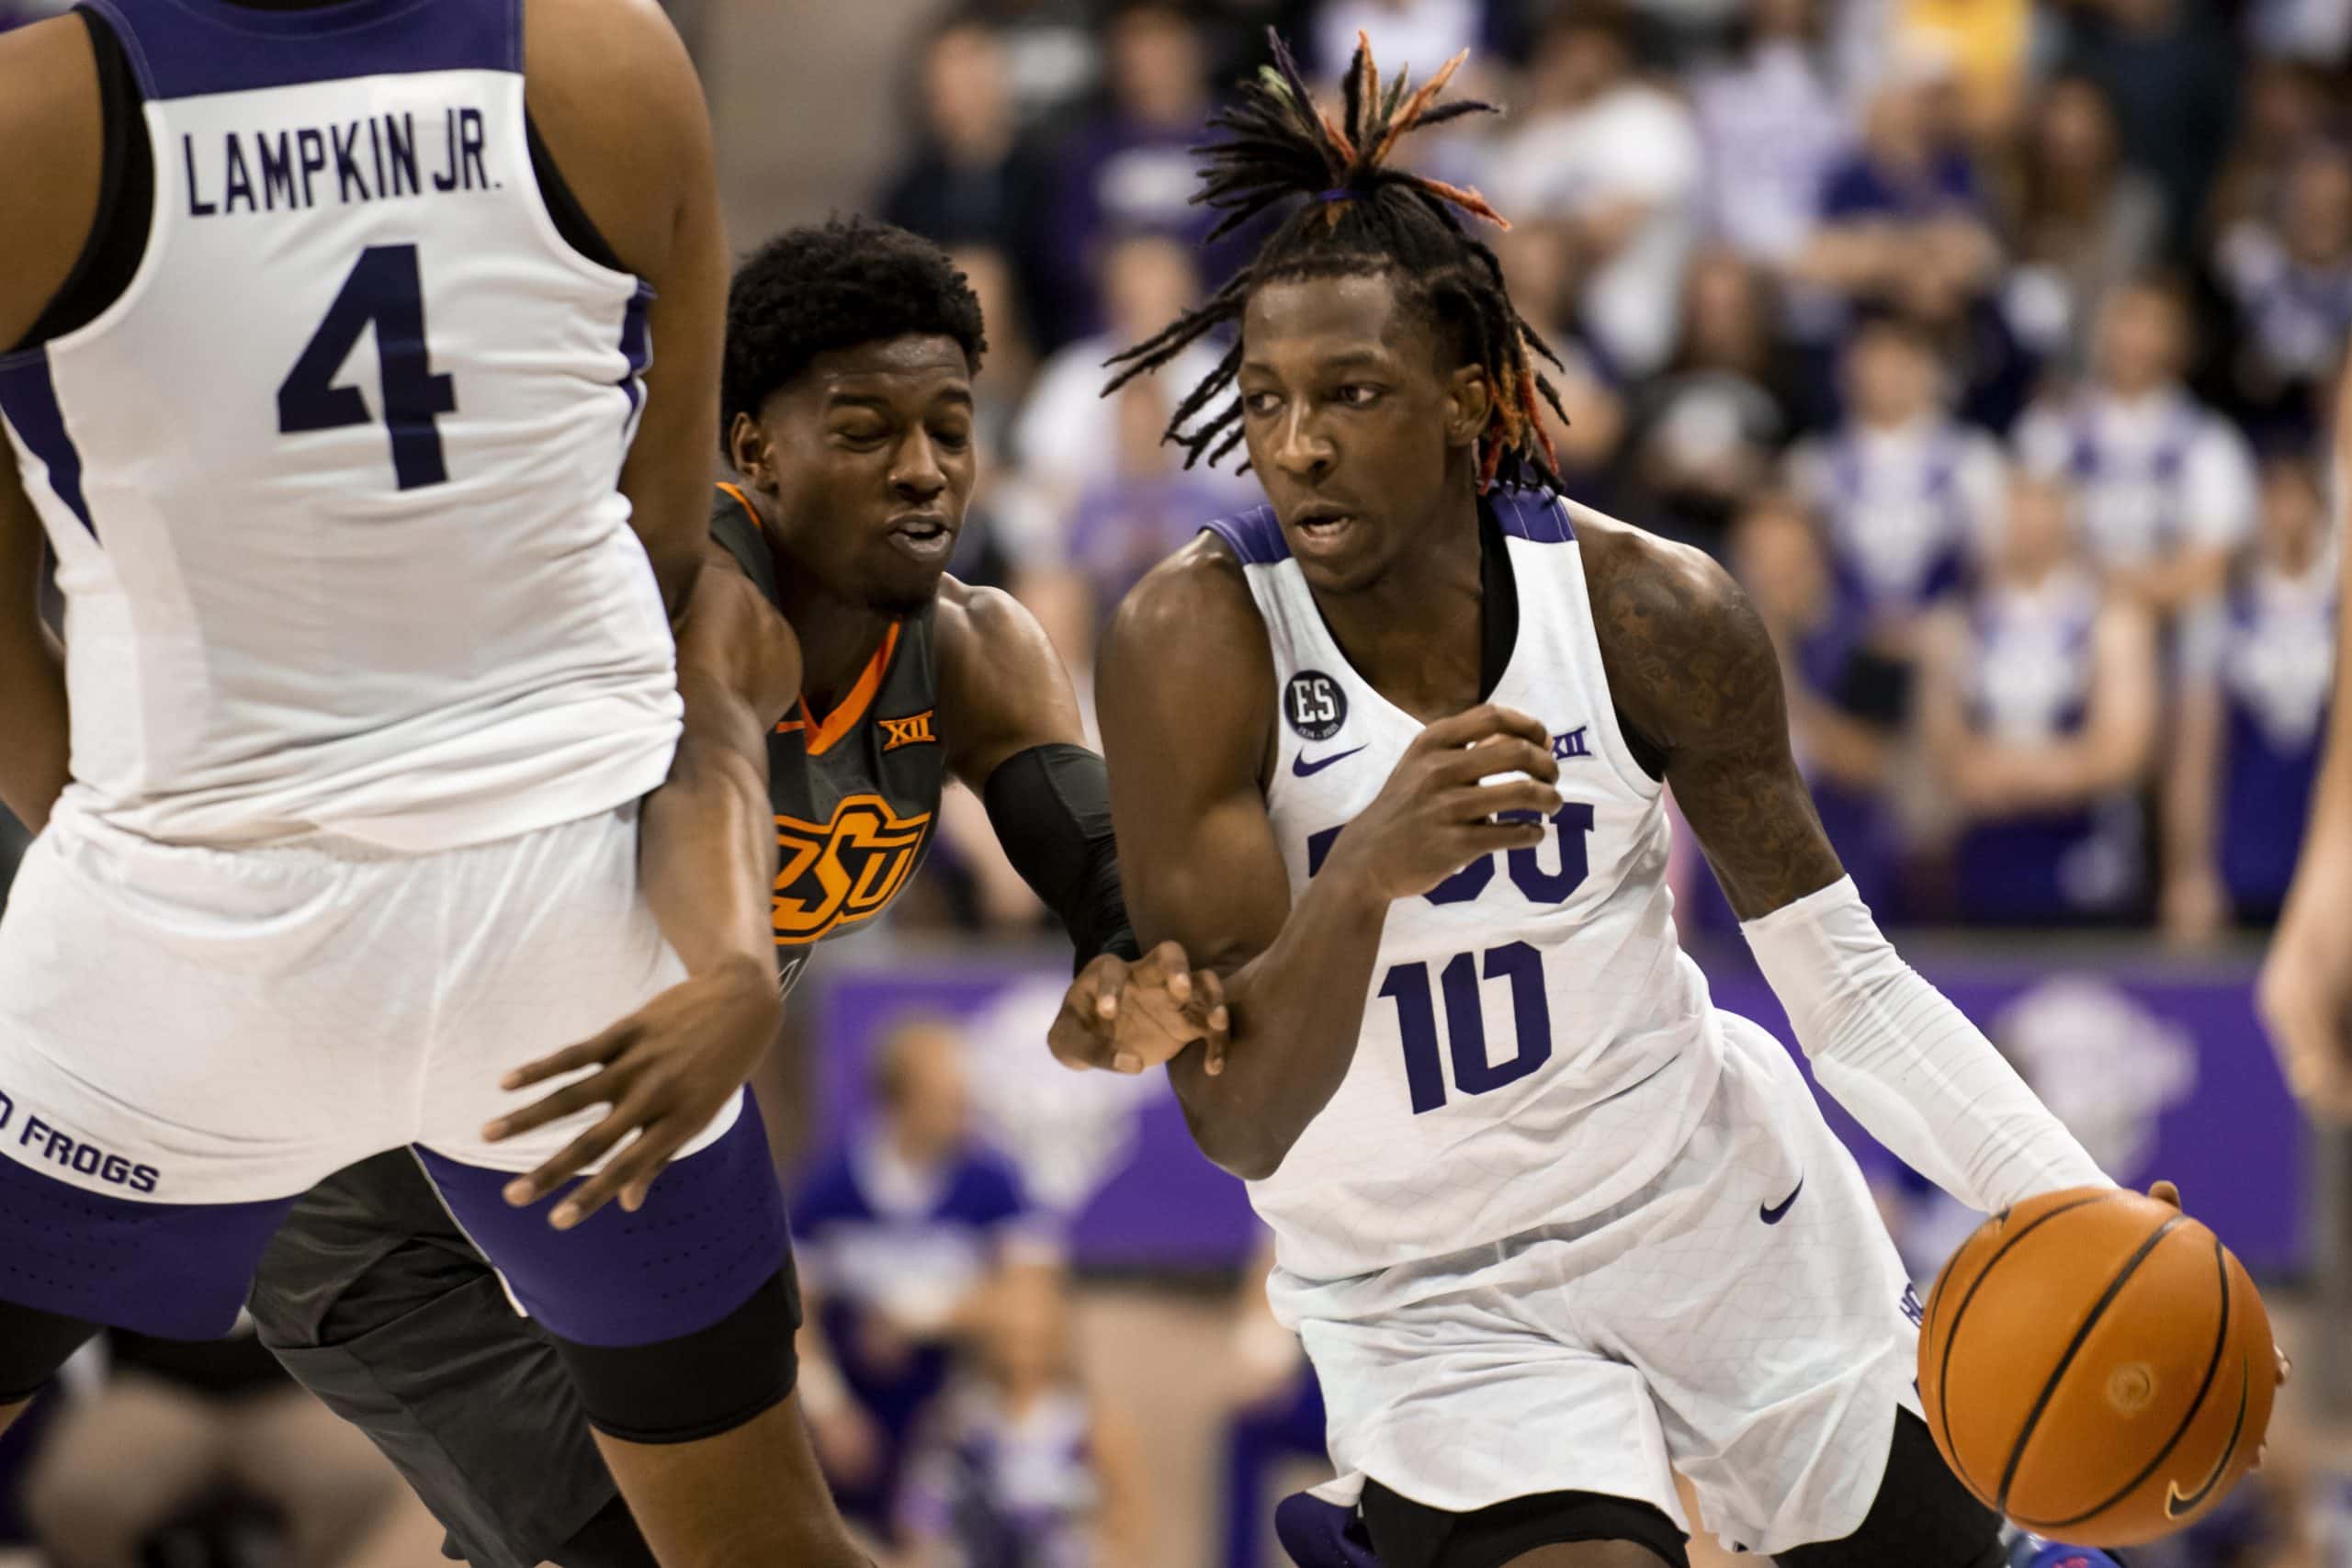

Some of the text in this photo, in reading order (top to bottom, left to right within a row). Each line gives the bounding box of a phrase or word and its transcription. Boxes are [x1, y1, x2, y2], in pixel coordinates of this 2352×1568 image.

[183, 107, 502, 216] LAMPKIN JR.
[277, 243, 458, 491] 4
[878, 710, 936, 750] XII
[1293, 678, 1335, 723] ES
[1378, 940, 1552, 1115] 10
[19, 1114, 160, 1192] FROGS
